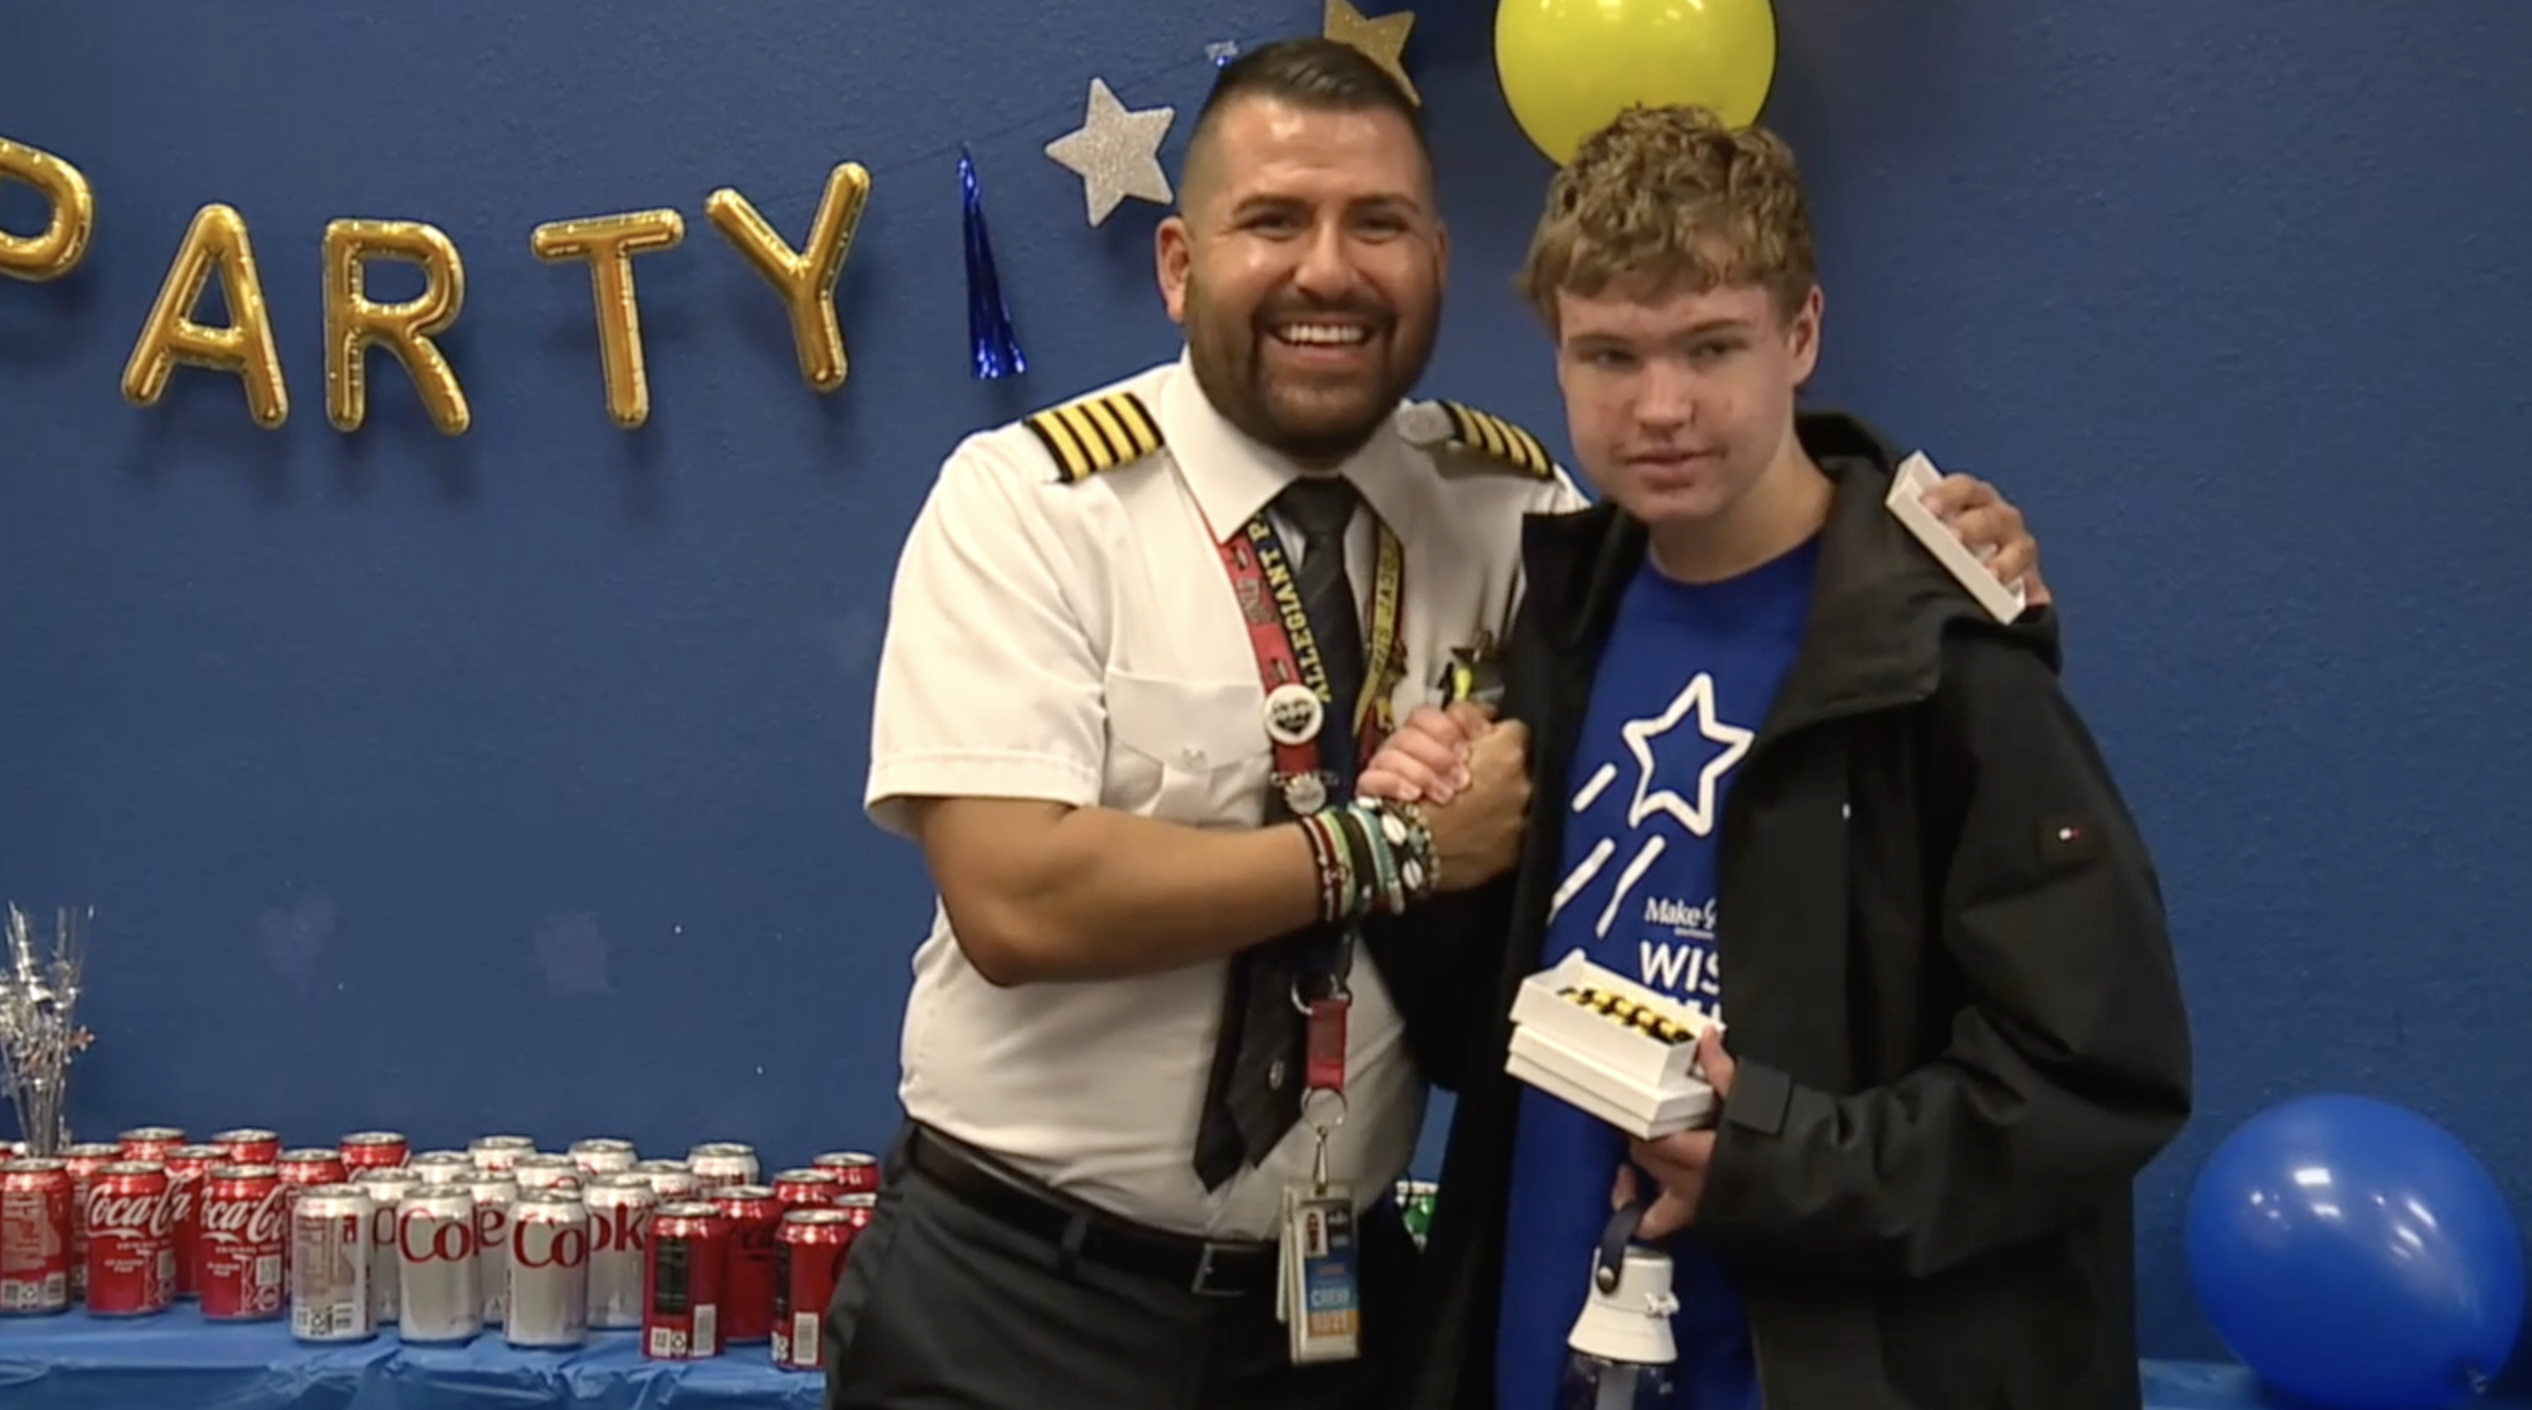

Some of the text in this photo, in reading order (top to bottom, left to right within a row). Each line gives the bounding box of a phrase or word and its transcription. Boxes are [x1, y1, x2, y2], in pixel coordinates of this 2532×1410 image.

[1258, 549, 1332, 702] ALLEGIANT
[400, 1207, 479, 1263] Co
[513, 1213, 590, 1268] Co
